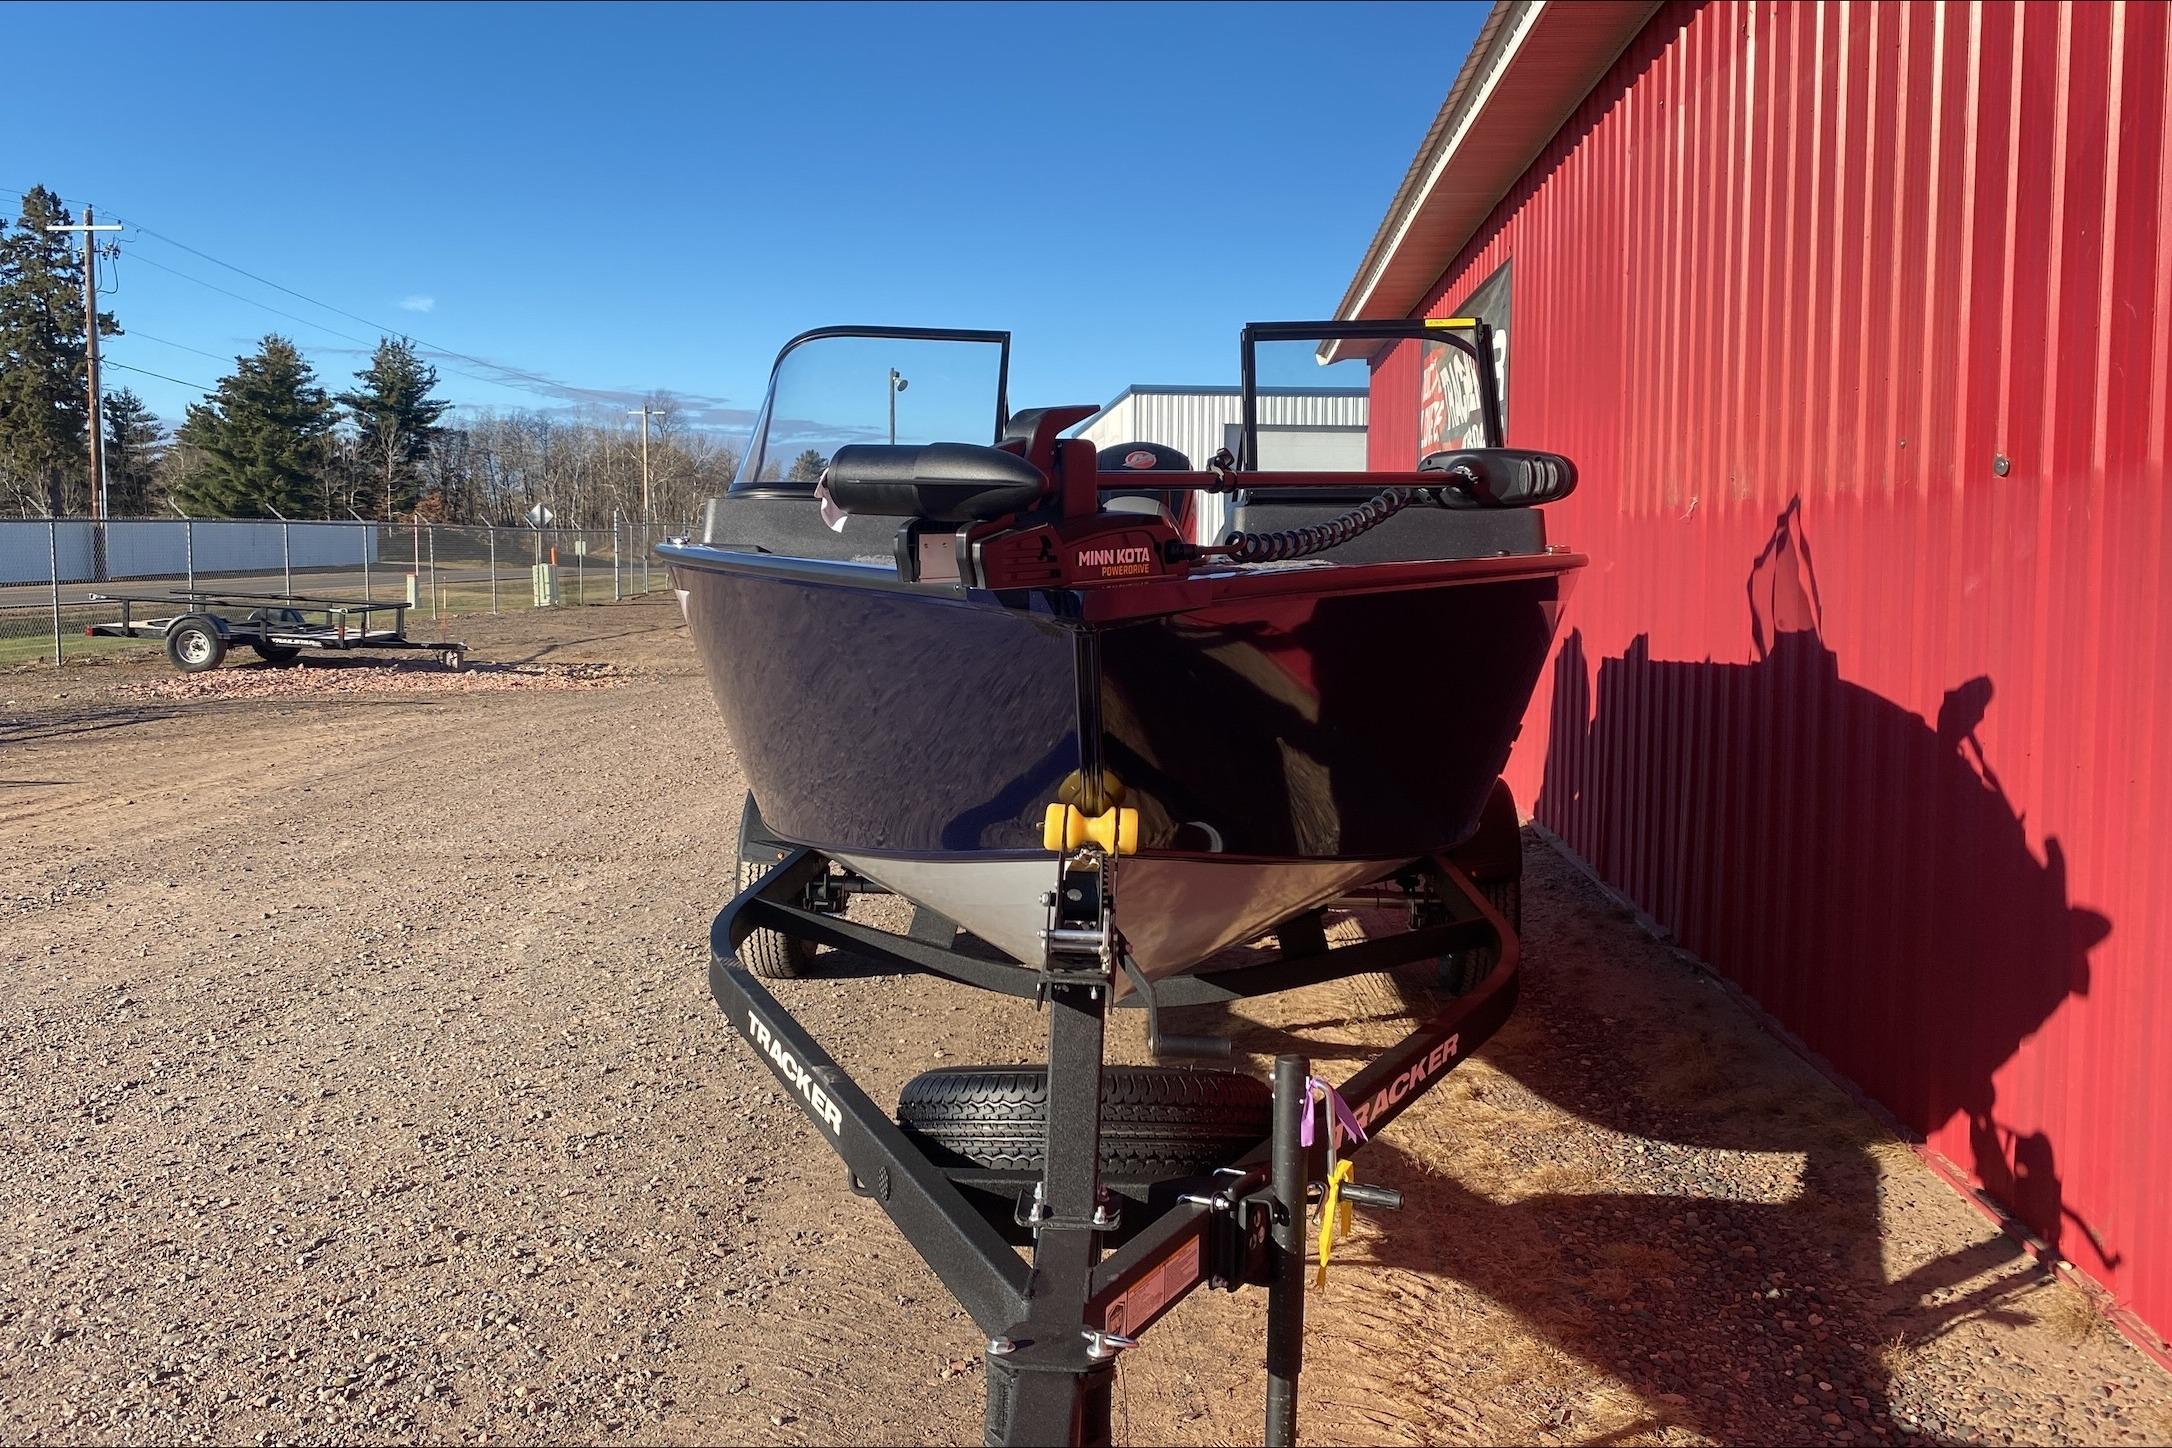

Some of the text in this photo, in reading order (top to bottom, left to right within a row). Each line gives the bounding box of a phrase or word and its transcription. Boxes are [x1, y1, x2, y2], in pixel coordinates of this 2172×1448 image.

[1078, 547, 1150, 567] MINN KOTA
[1101, 563, 1149, 577] POWERDRIVE
[747, 1009, 843, 1137] TRACKER
